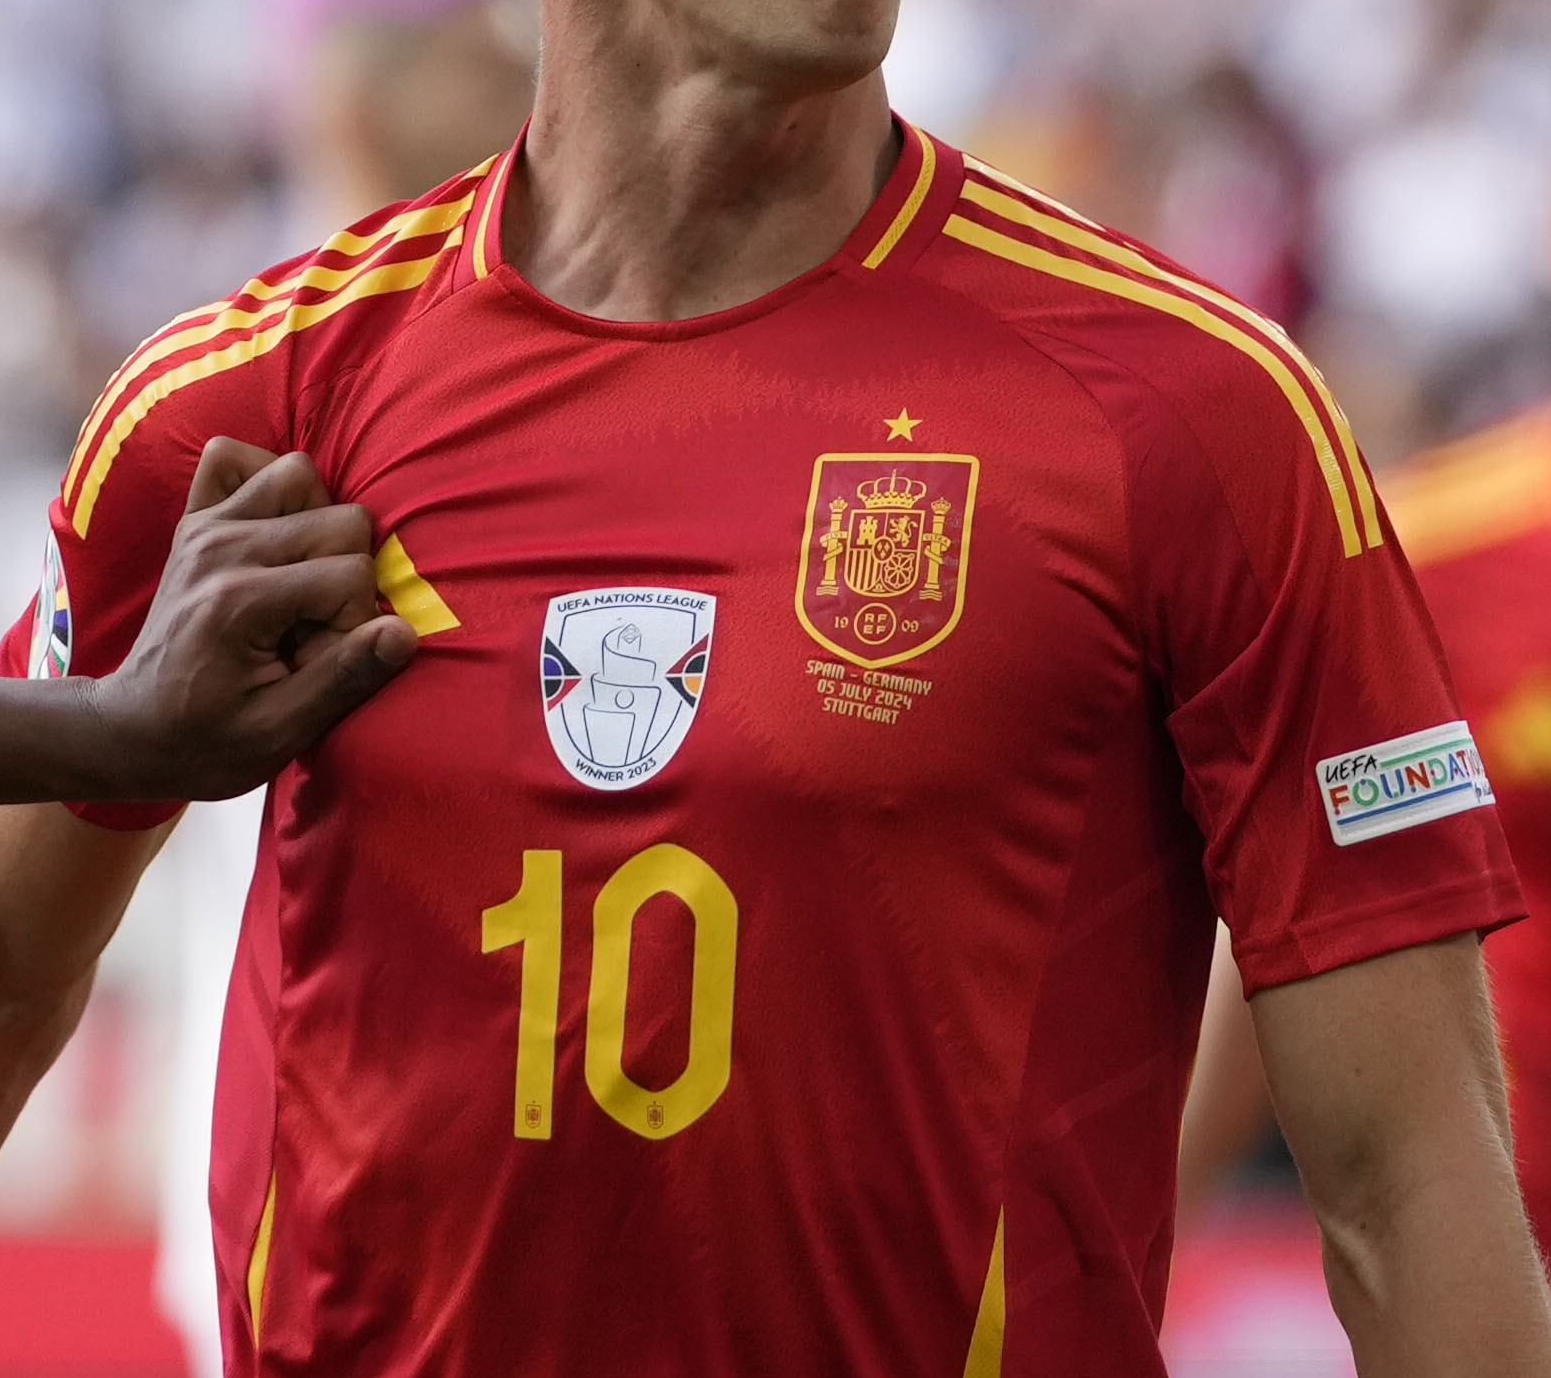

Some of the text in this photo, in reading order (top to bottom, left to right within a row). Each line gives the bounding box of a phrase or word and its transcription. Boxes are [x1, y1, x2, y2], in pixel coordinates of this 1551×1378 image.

[557, 593, 709, 614] UEFA NATIONS LEAGUE
[805, 659, 846, 680] SPAIN
[863, 670, 933, 696] GERMANY
[817, 678, 913, 711] 05 JULY 2024
[821, 696, 901, 726] STUTTGART
[574, 757, 658, 782] WINNER 2023
[1324, 753, 1378, 784] UEFA
[481, 843, 739, 1141] 10
